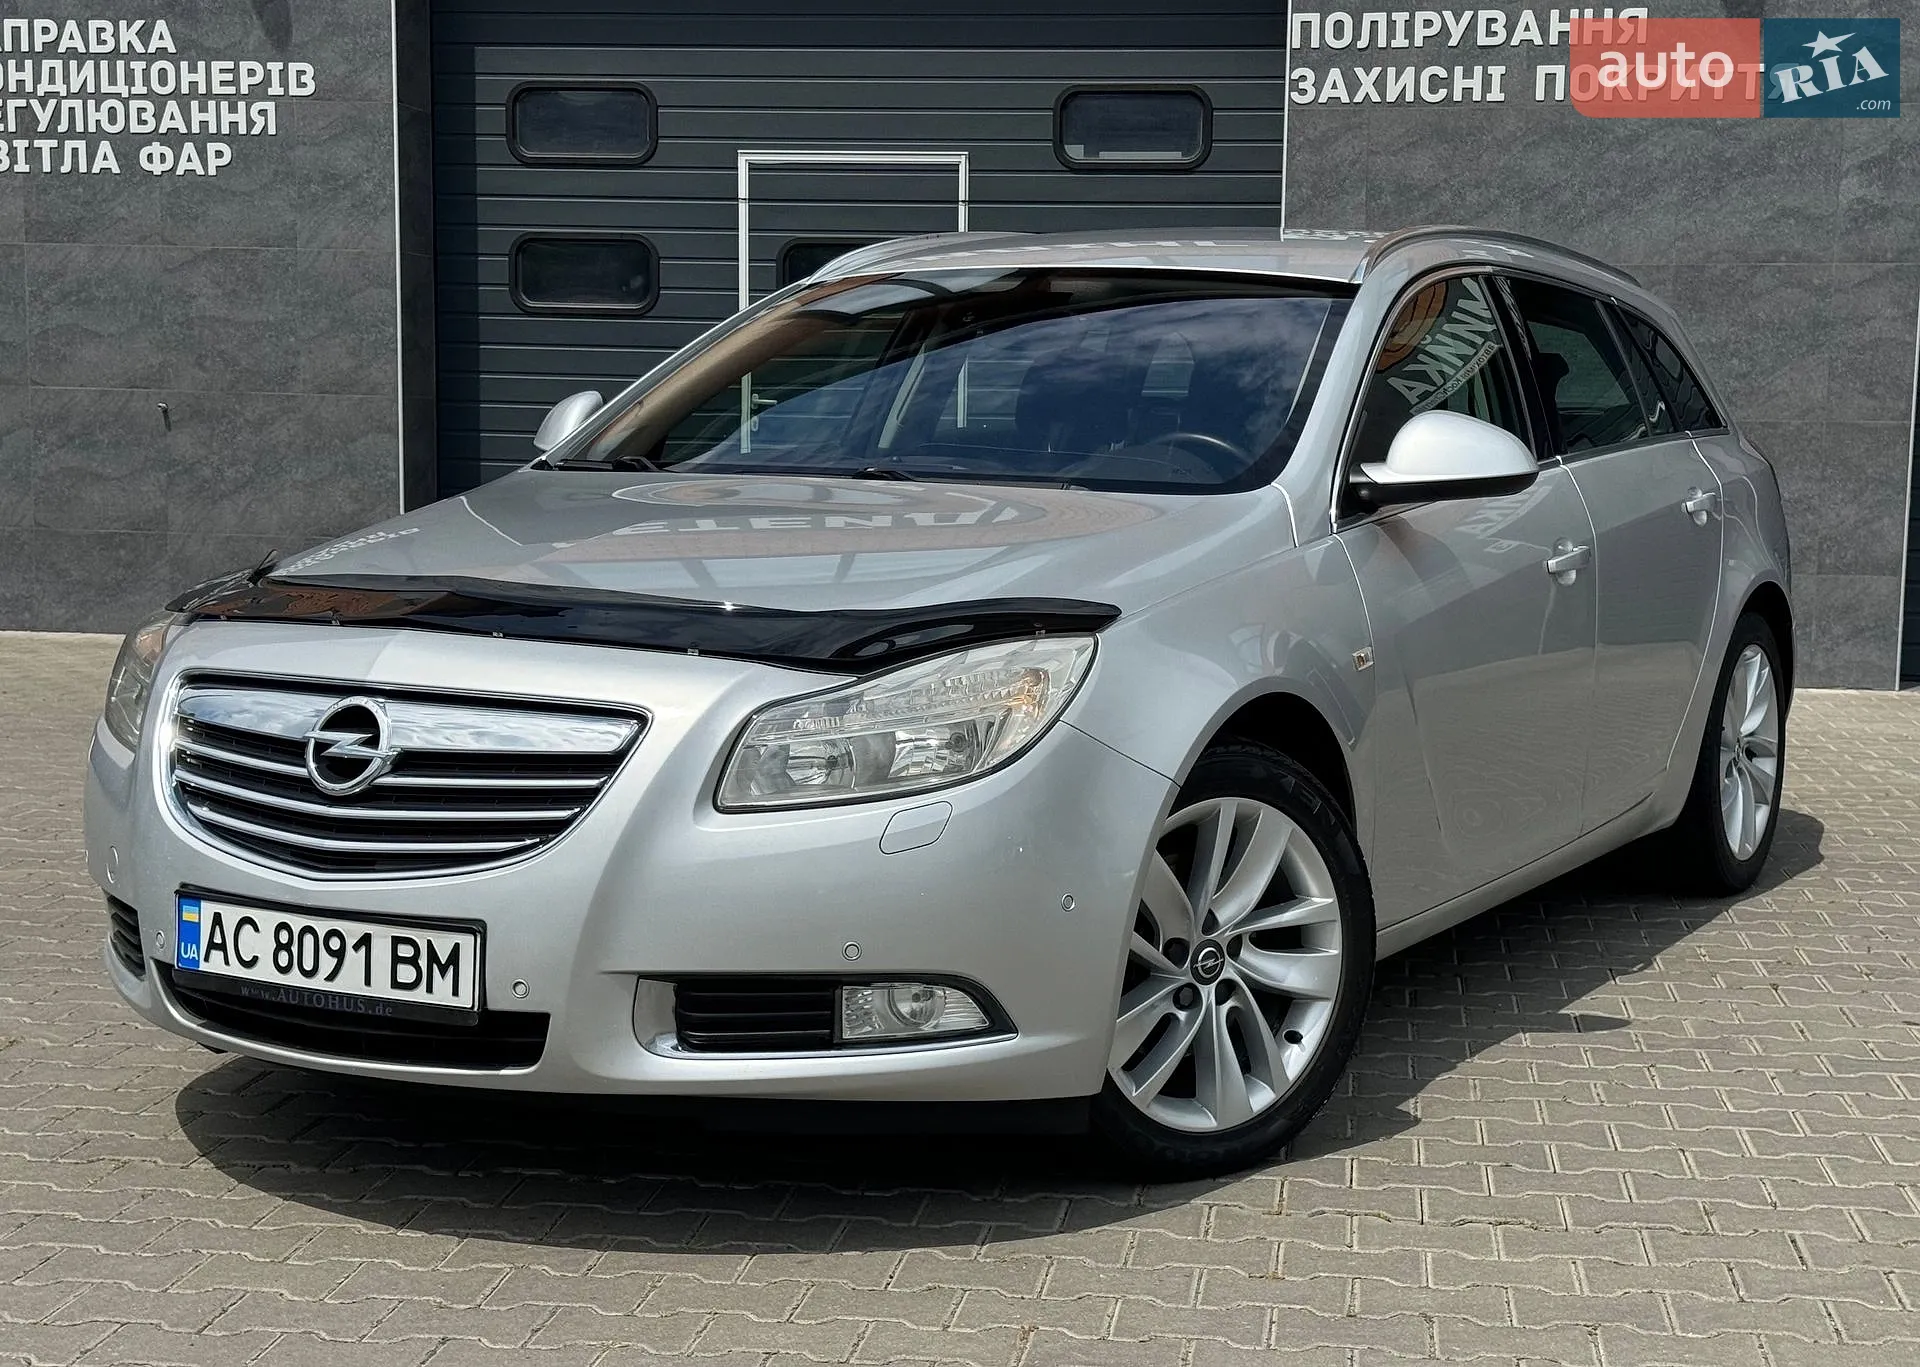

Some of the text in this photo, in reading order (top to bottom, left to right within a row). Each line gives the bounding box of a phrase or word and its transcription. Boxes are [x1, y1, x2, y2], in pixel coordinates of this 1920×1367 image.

[0, 18, 177, 53] ПРАВКА
[1291, 8, 1649, 49] ПОЛІРУВАННЯ
[0, 59, 316, 97] НДИЦІОНЕРІВ
[1290, 65, 1507, 104] ЗАХИСНІ
[0, 98, 277, 135] ГУЛЮВАННЯ
[139, 141, 232, 176] ФАР
[181, 942, 199, 961] UA
[203, 911, 461, 998] AC 8091 BM
